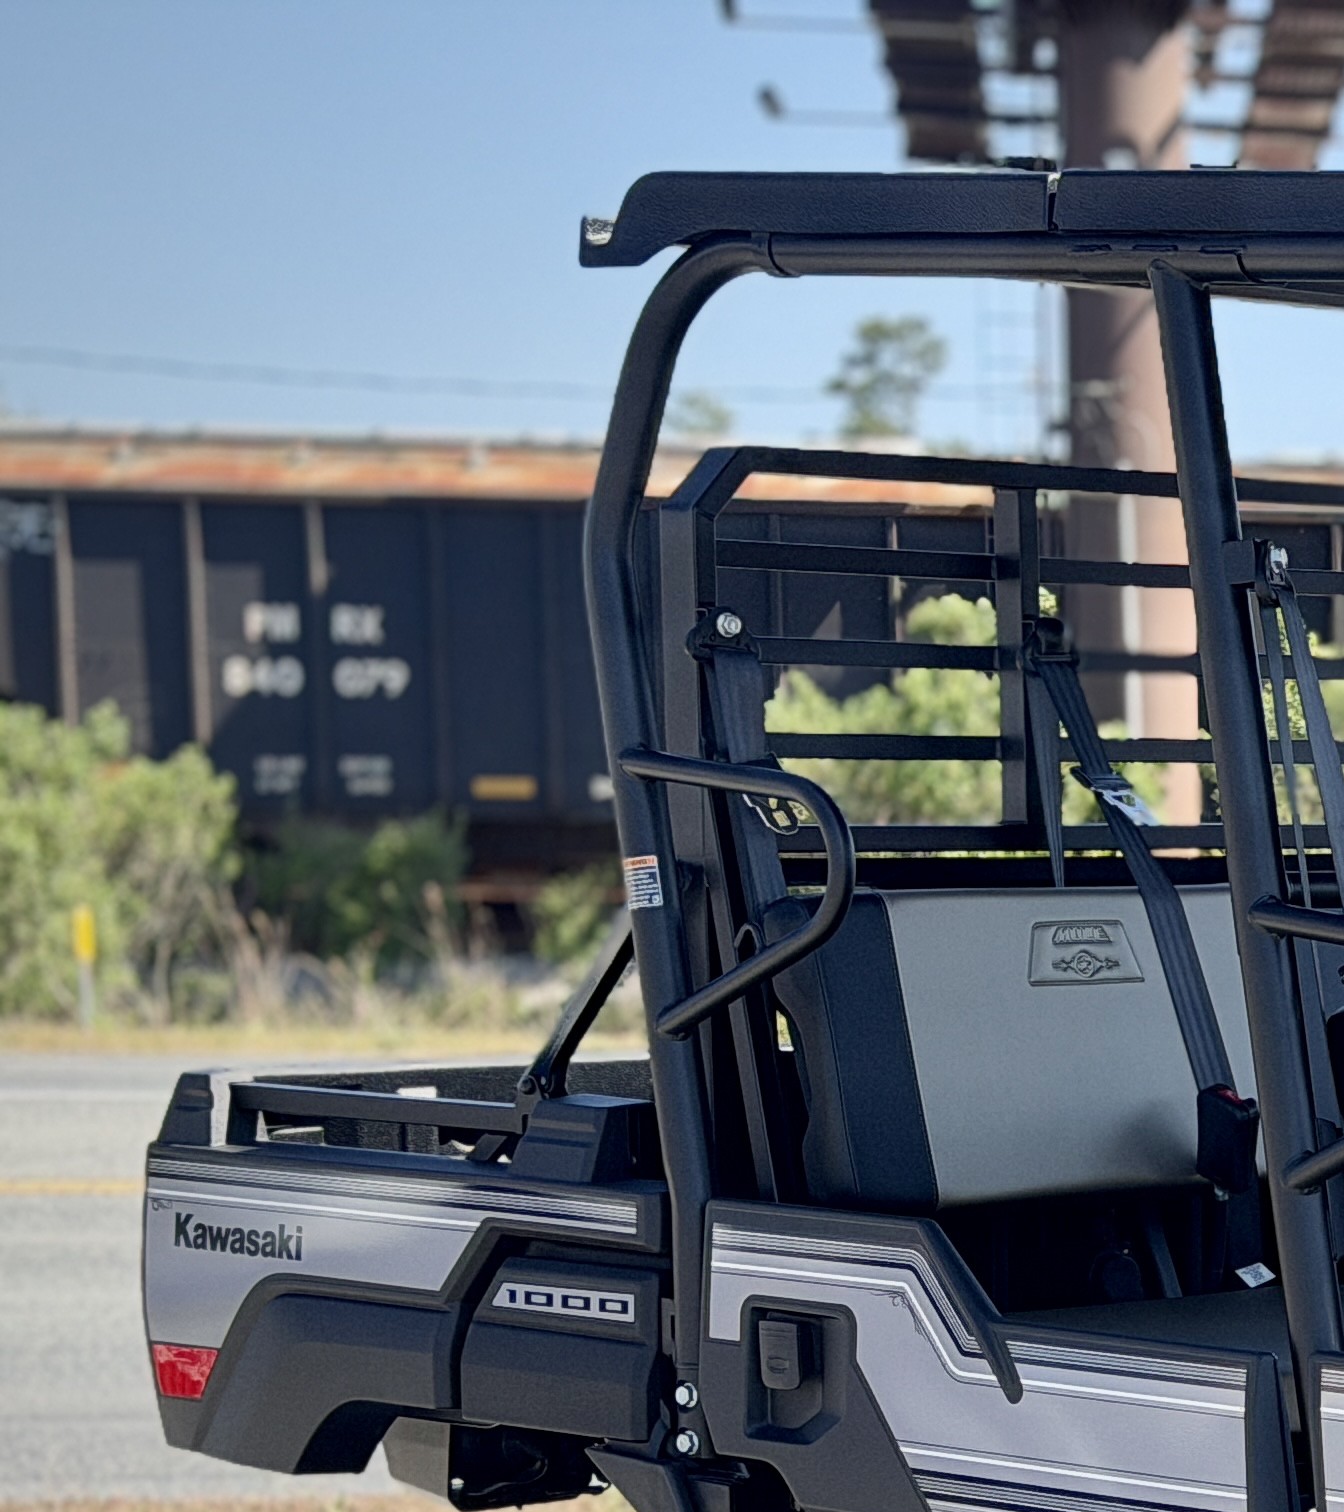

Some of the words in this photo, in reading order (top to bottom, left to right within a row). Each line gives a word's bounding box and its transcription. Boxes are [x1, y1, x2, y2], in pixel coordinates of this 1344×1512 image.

[1052, 925, 1112, 945] MULE
[174, 1212, 304, 1262] Kawasaki
[506, 1289, 629, 1315] 1000
